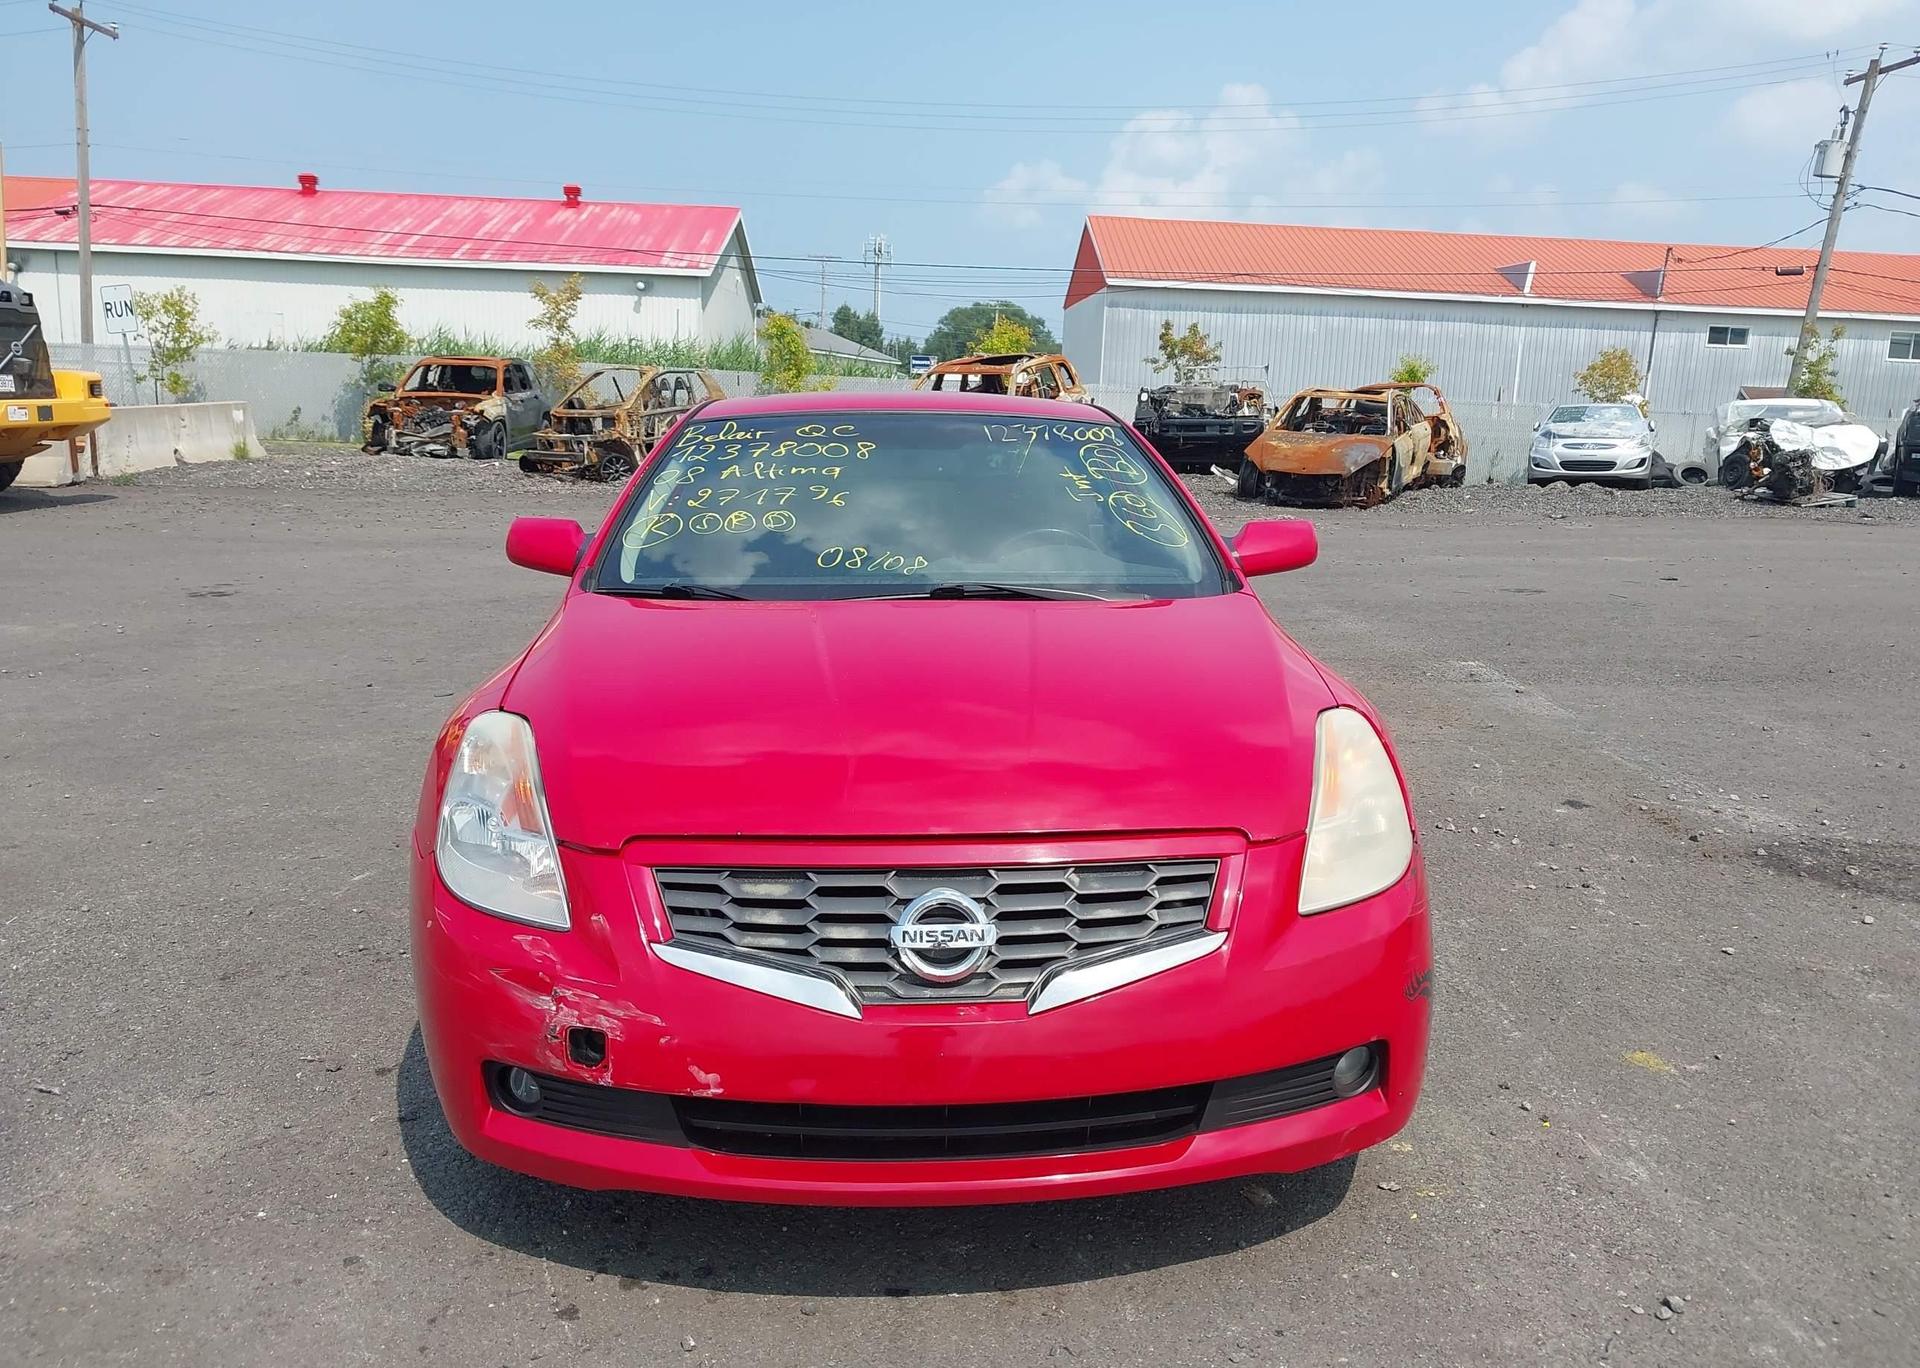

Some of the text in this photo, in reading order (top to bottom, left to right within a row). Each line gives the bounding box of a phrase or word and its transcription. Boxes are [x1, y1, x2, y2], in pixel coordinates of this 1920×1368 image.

[104, 299, 134, 319] RUN
[672, 441, 877, 463] 12378008
[653, 461, 848, 485] 08 Altima
[902, 928, 985, 944] NISSAN
